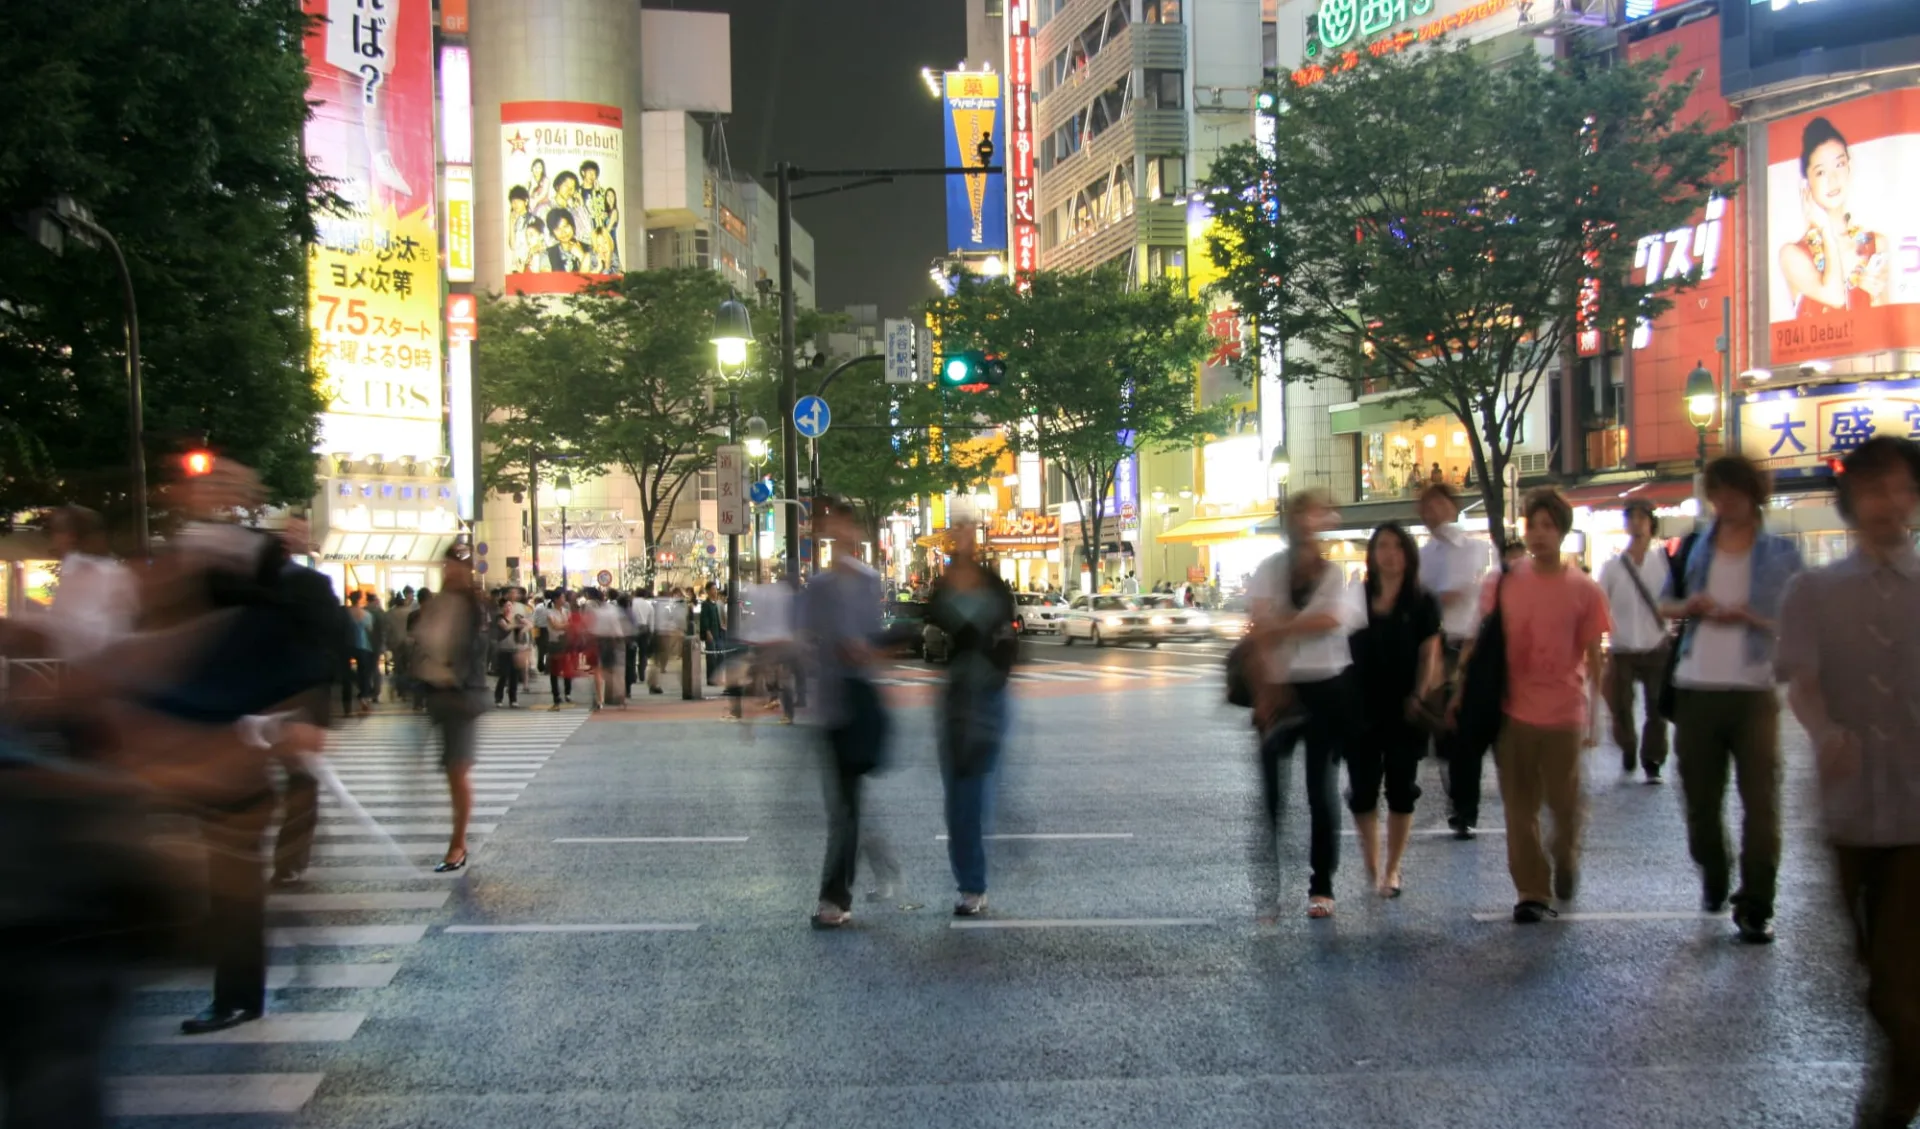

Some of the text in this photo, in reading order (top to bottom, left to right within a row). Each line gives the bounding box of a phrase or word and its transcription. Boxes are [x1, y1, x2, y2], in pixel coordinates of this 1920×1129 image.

[353, 0, 386, 104] ば?
[534, 128, 567, 146] 904i
[575, 129, 619, 151] Debut!
[330, 264, 414, 301] ヨメ次第
[1810, 320, 1855, 343] Debut!
[896, 324, 908, 378] 渋谷駅前
